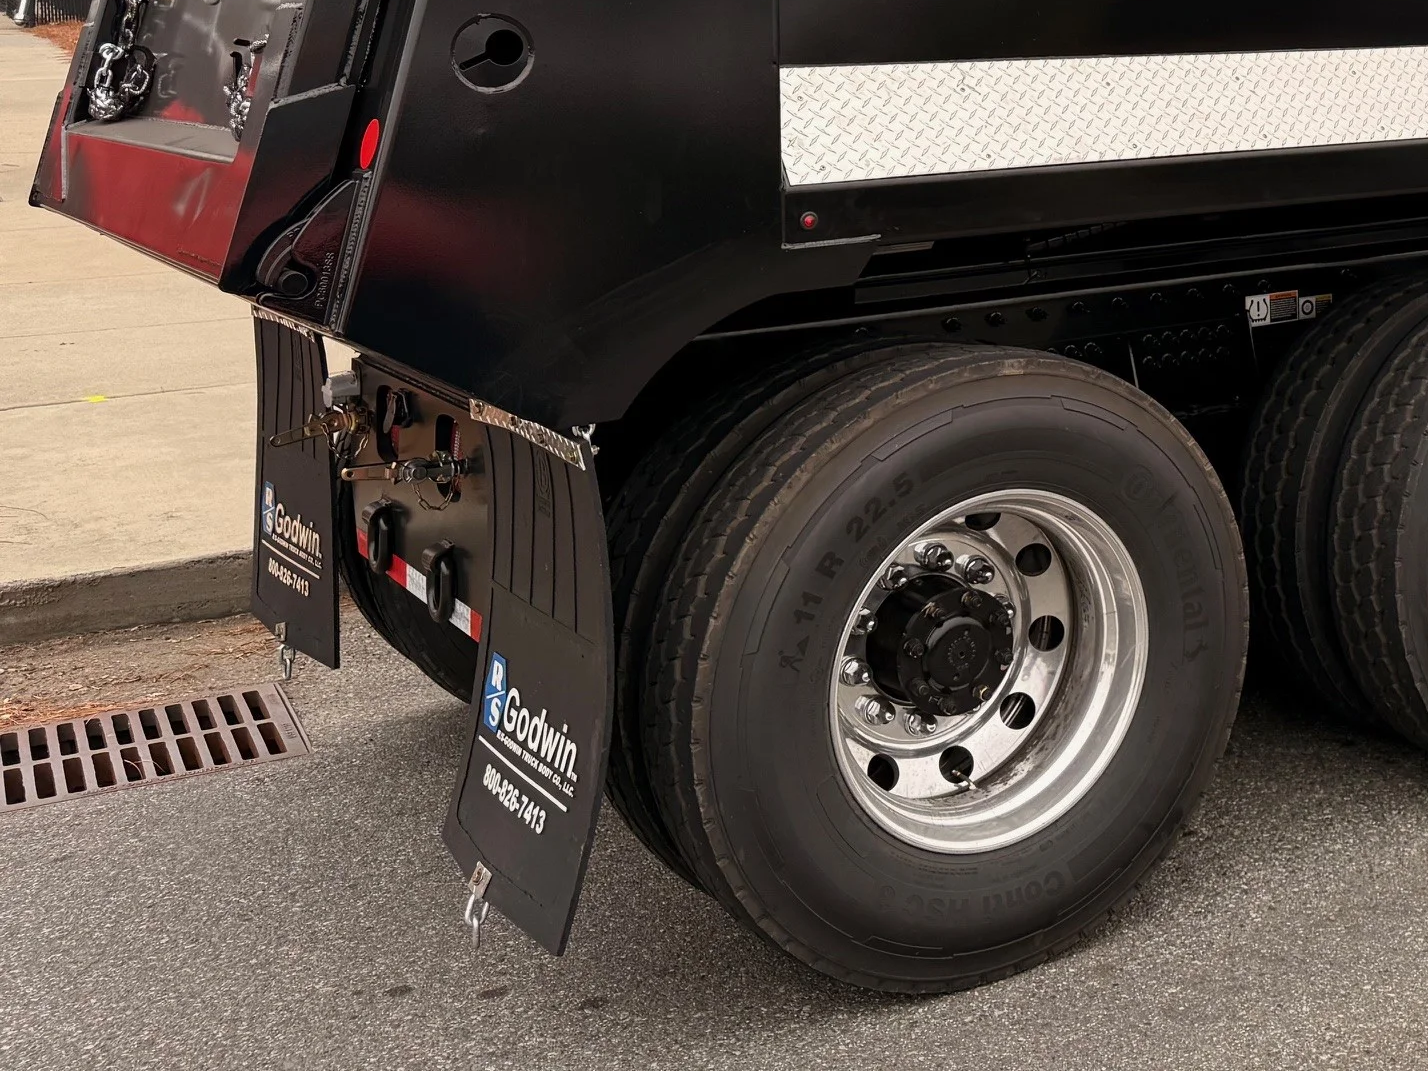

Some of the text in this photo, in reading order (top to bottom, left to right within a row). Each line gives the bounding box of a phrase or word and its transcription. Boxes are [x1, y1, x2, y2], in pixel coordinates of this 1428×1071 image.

[275, 503, 320, 557] Godwin
[793, 591, 824, 625] 11
[815, 550, 845, 580] R
[845, 471, 914, 542] 22.5
[268, 557, 310, 597] 800-826-7413
[491, 659, 503, 692] R
[489, 697, 503, 727] S
[503, 687, 577, 779] Godwin
[521, 749, 540, 770] TRUCK
[538, 762, 553, 779] BODY
[482, 763, 546, 835] 800-826-7413
